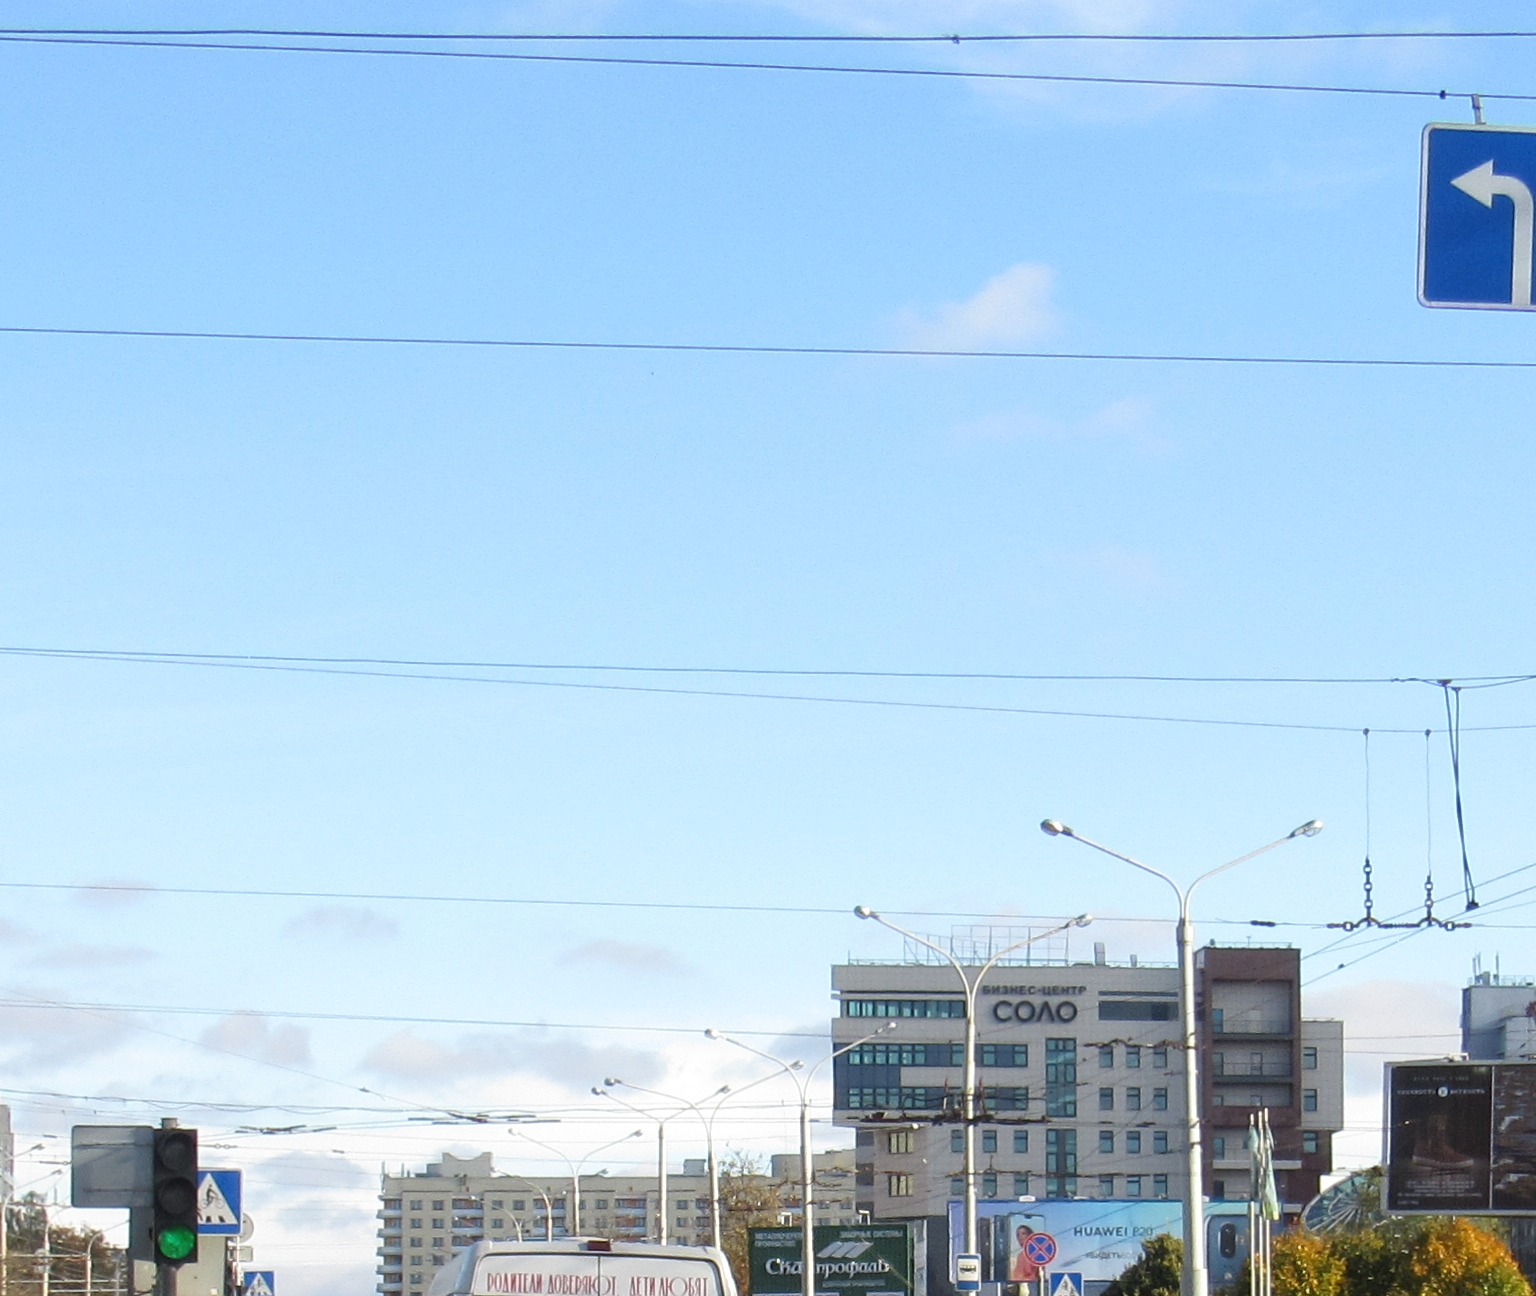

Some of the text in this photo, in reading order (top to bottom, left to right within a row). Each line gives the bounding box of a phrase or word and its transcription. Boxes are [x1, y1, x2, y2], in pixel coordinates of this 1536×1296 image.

[982, 985, 1087, 996] БИЗНЕС-ЦЕНТР
[993, 1000, 1078, 1023] СОЛО
[1073, 1226, 1128, 1237] HUAWEI
[486, 1273, 543, 1293] РОДИТЕЛИ
[629, 1276, 656, 1296] ДЕТИ
